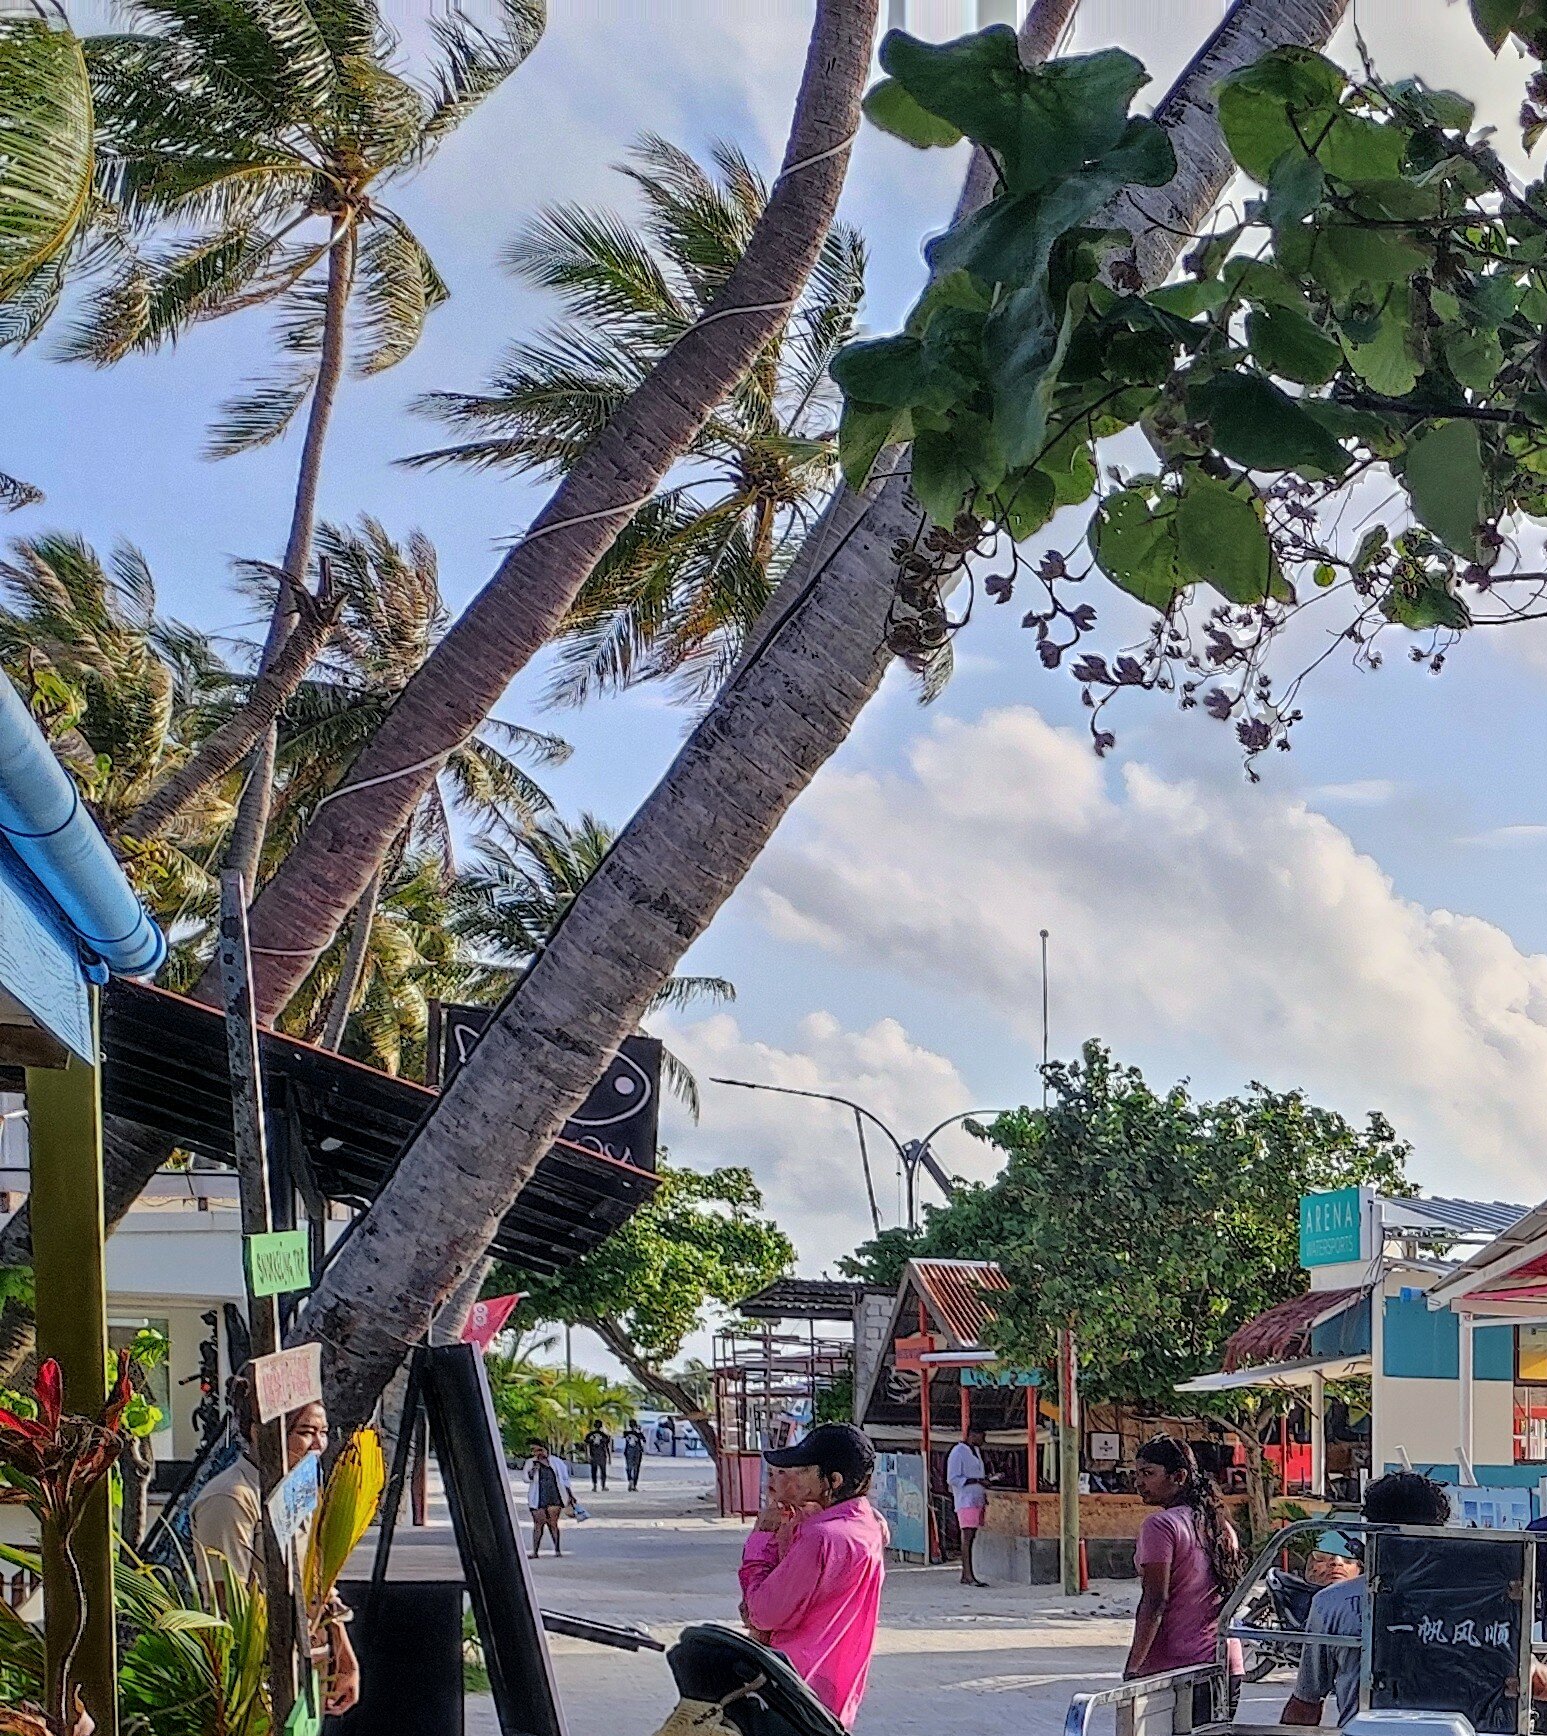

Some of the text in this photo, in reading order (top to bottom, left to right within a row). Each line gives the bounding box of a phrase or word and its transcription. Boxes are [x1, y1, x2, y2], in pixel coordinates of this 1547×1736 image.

[1305, 1201, 1353, 1234] ARENA
[1306, 1234, 1354, 1257] WATERSPORTS
[1386, 1614, 1514, 1652] 一帆风顺
